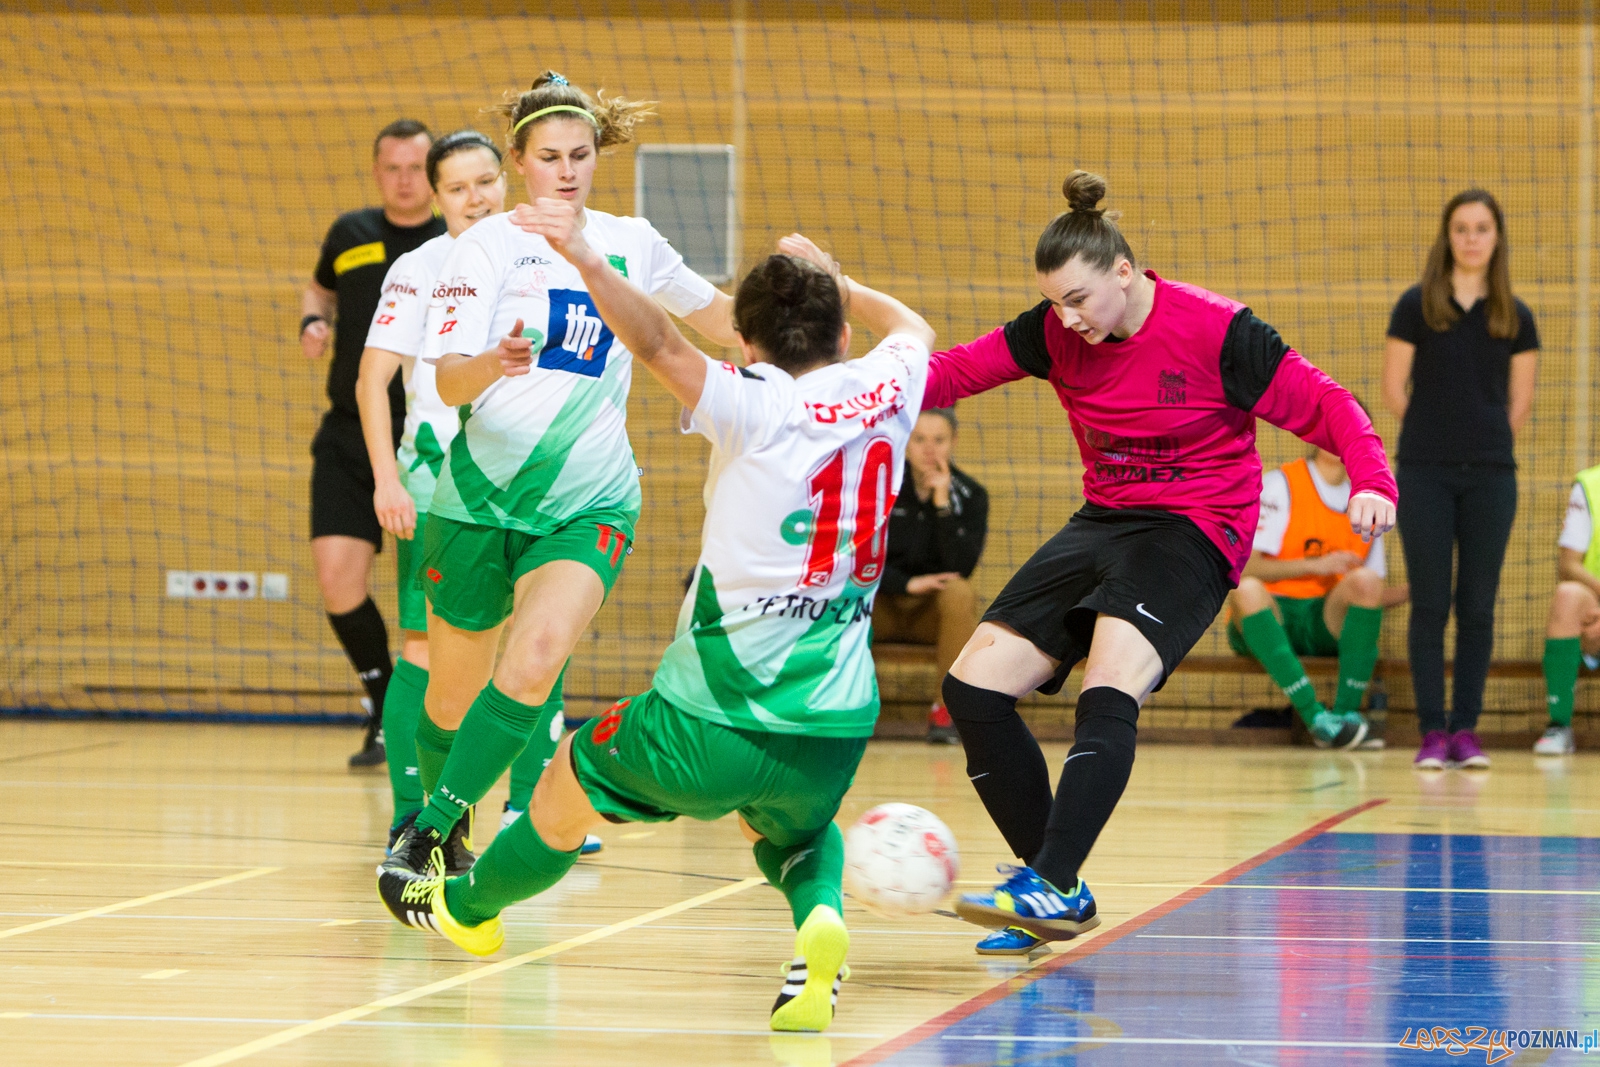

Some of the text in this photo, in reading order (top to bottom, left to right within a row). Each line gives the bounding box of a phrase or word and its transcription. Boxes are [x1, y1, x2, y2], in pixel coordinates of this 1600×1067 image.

[1094, 460, 1187, 482] PRIMEX
[798, 435, 898, 589] 10
[596, 524, 627, 569] 11
